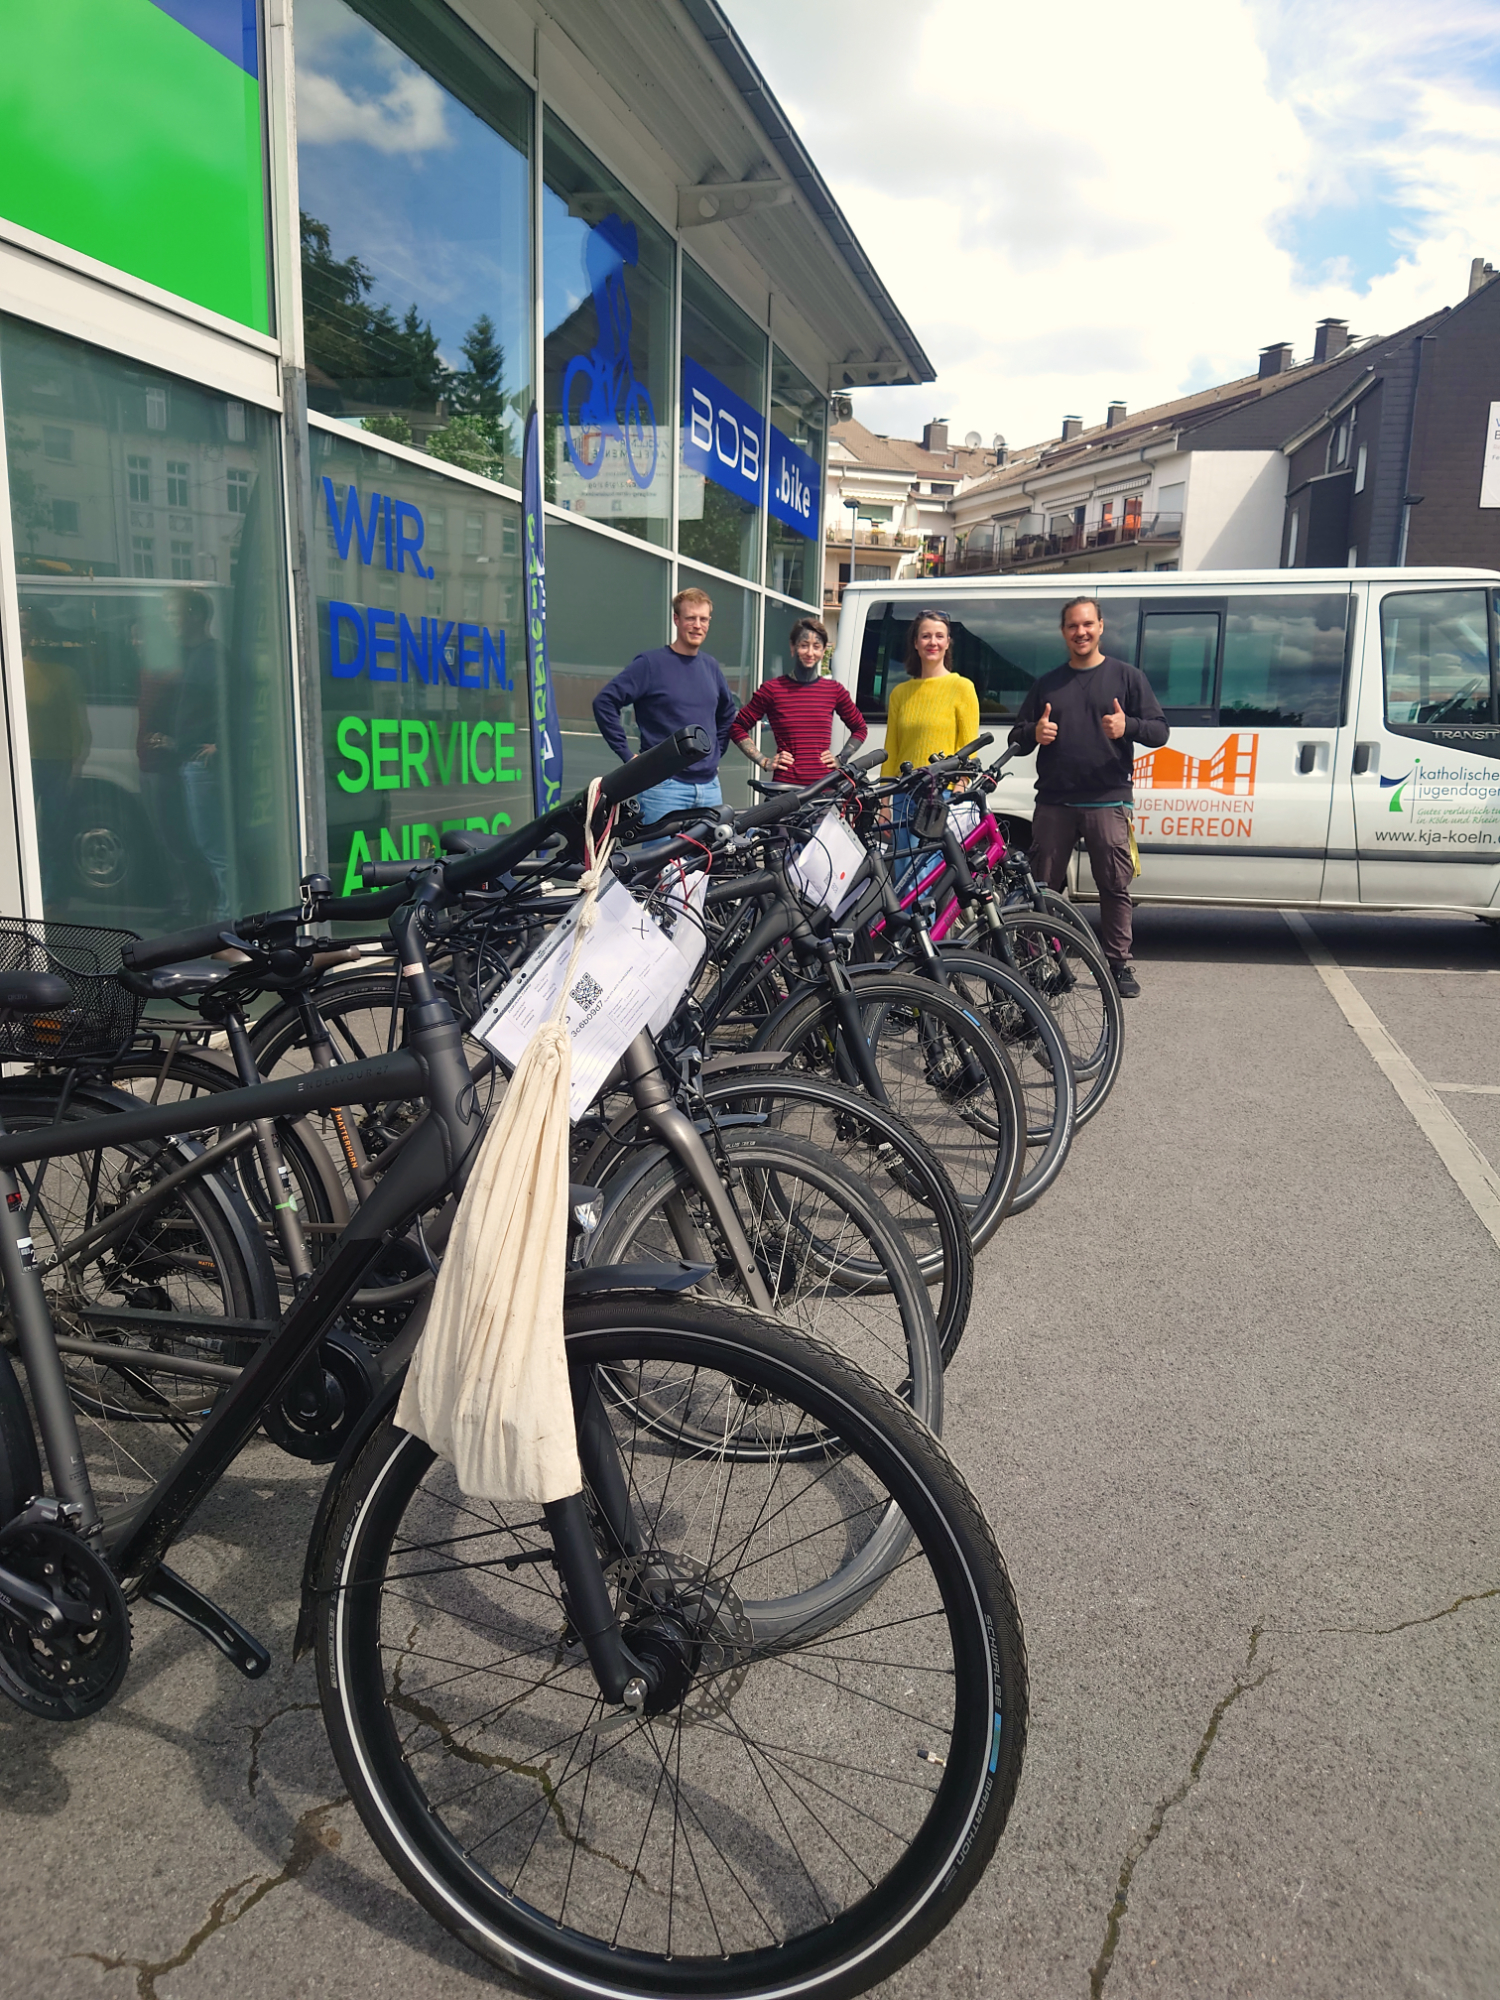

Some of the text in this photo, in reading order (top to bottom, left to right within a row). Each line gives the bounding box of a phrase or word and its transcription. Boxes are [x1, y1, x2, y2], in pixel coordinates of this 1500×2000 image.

[690, 387, 811, 519] BOB .bike
[322, 475, 436, 580] WIR.
[329, 600, 515, 692] DENKEN.
[1431, 729, 1500, 740] TRANSIT
[336, 715, 523, 794] SERVICE.
[1419, 765, 1500, 781] katholische
[1418, 782, 1500, 800] jugendage
[1133, 798, 1254, 813] UGENDWOHNEN
[1160, 816, 1253, 838] GEREON
[1428, 815, 1449, 825] Köln
[1450, 815, 1470, 825] und
[1375, 829, 1500, 846] www.kja-koeln.
[570, 999, 604, 1039] 3c6b09d7
[297, 1068, 373, 1091] ENDEAVOUR
[335, 1113, 359, 1169] MATTERHORN
[955, 1613, 1002, 1867] SCHWALBE MARATHON
